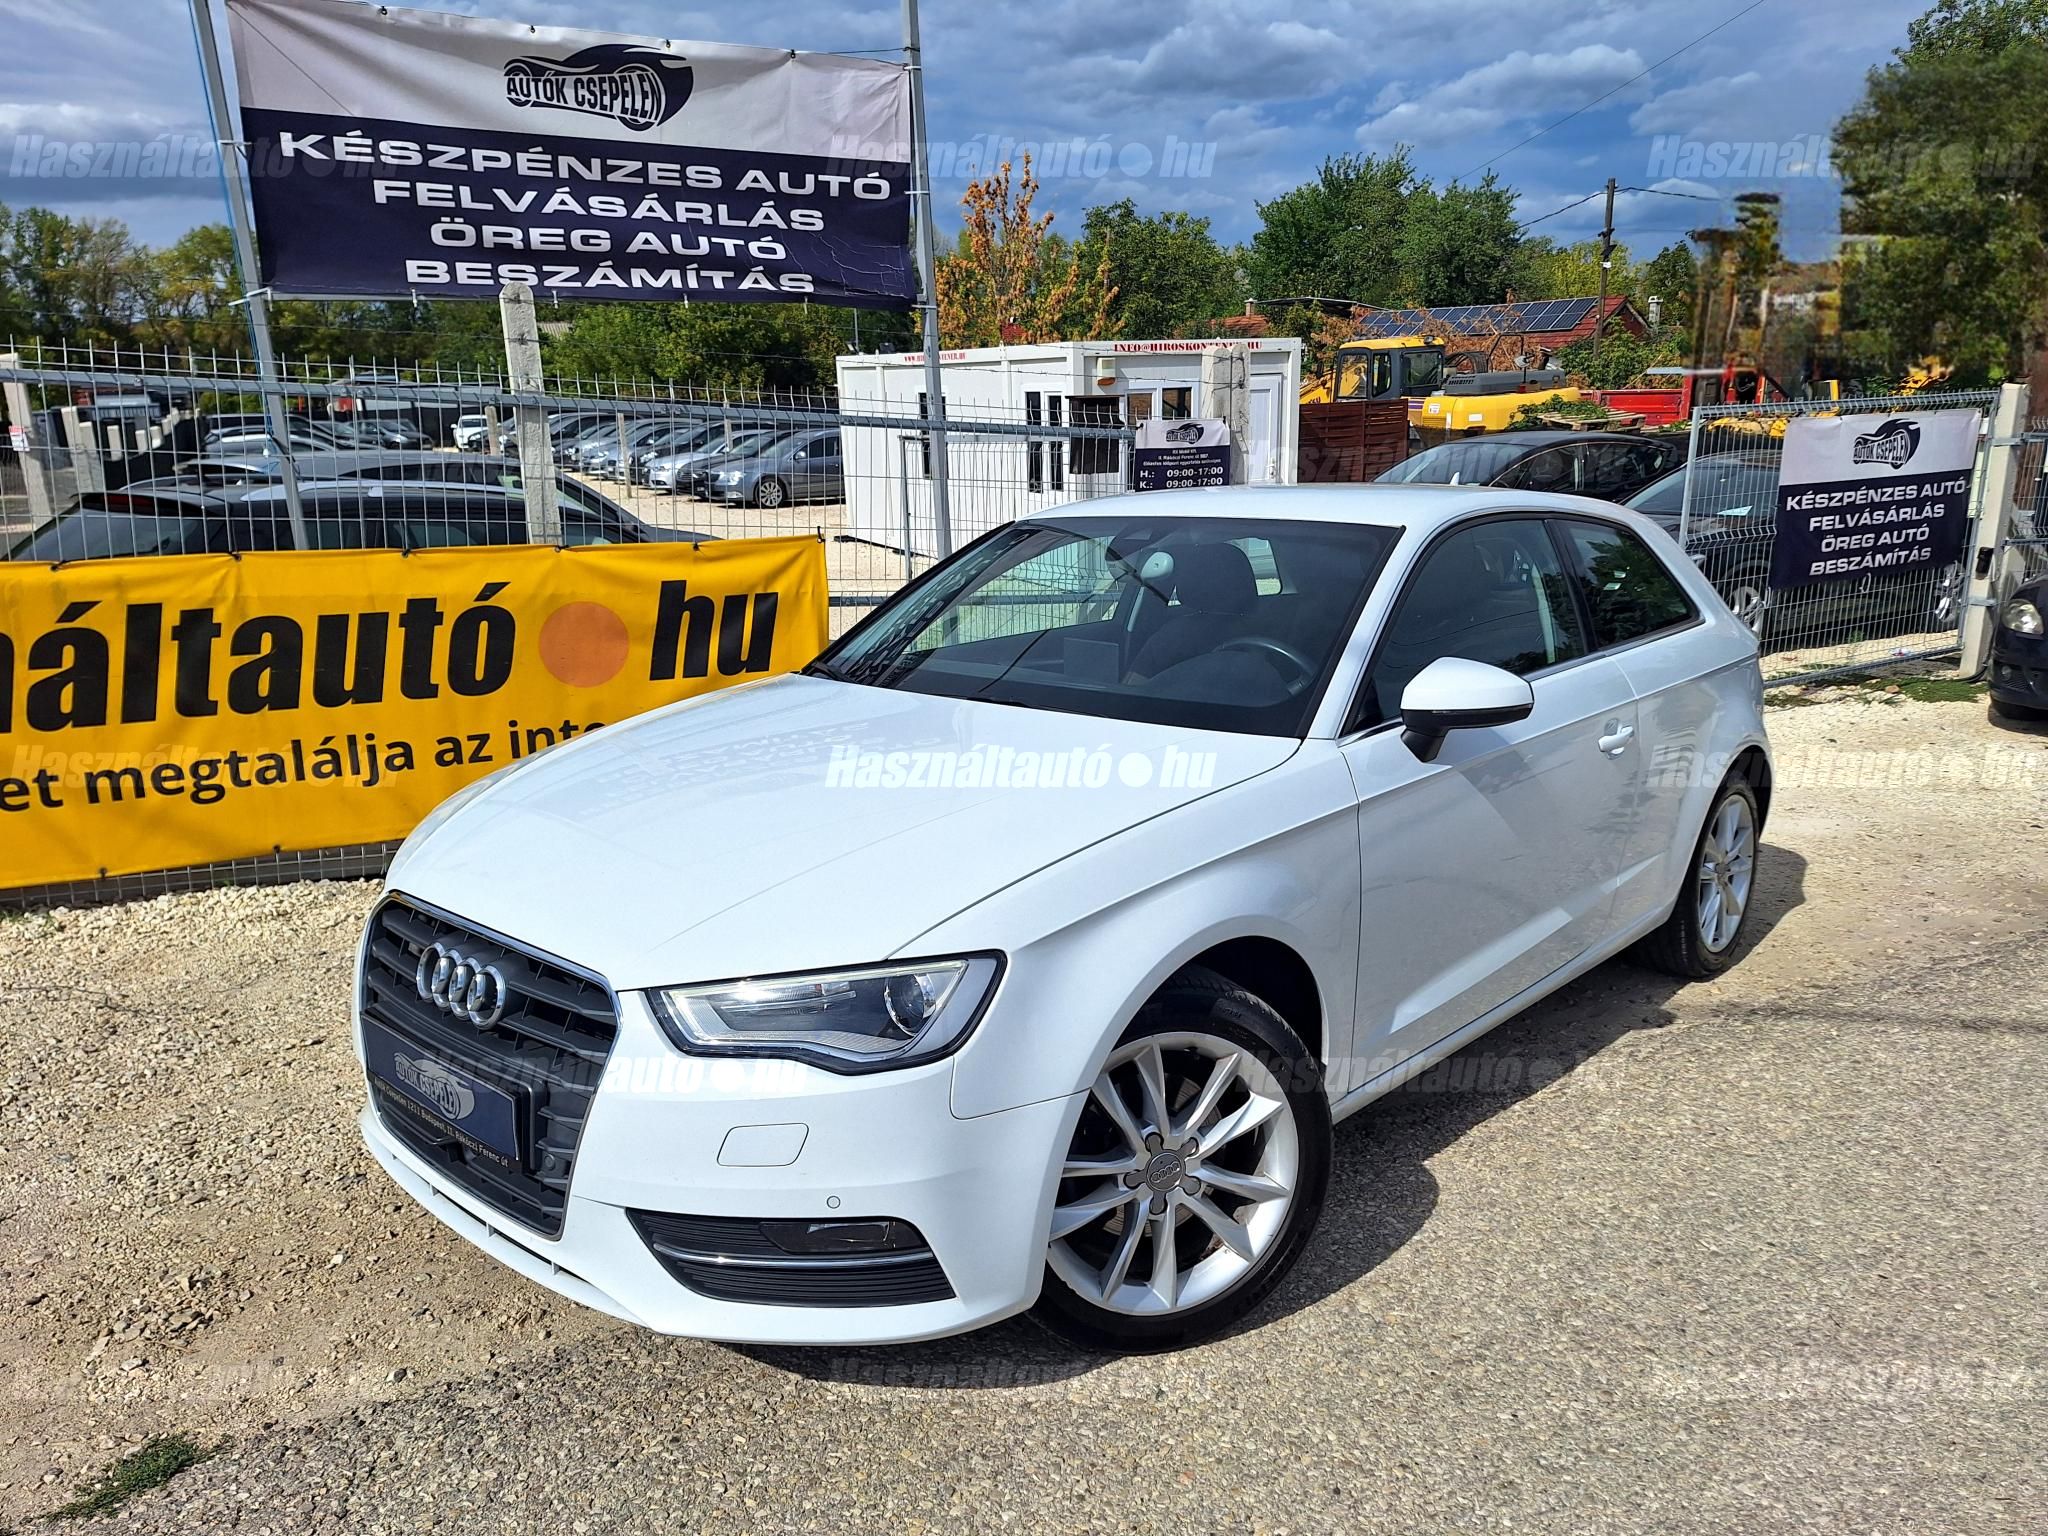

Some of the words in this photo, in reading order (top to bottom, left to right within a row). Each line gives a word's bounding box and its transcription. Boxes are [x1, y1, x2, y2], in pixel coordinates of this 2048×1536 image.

[506, 70, 569, 104] AUTÓK
[573, 71, 659, 121] CSEPELEN
[279, 130, 720, 189] KÉSZPÉNZES
[735, 168, 892, 201] AUTÓ
[372, 179, 825, 232] FELVÁSÁRLÁS
[430, 216, 612, 254] ÖREG
[626, 230, 787, 262] AUTÓ
[405, 259, 815, 294] BESZÁMÍTÁS
[1140, 470, 1155, 478] H.:
[1166, 466, 1224, 478] 09:00-17:00
[1140, 481, 1153, 489] K.:
[1166, 477, 1223, 488] 09:00-17:00
[1785, 485, 1918, 511] KÉSZPÉNZES
[1920, 476, 1967, 498] AUTÓ
[1808, 502, 1946, 532] FELVÁSÁRLÁS
[1820, 533, 1876, 553] ÖREG
[1879, 523, 1930, 547] AUTÓ
[1808, 547, 1932, 576] BESZÁMÍTÁS
[0, 581, 516, 733] áltautó
[649, 579, 779, 682] hu
[83, 732, 415, 804] megtalálja
[442, 732, 494, 768] az
[508, 719, 606, 759] int
[407, 1100, 421, 1116] 1211
[478, 1144, 500, 1163] Ferenc
